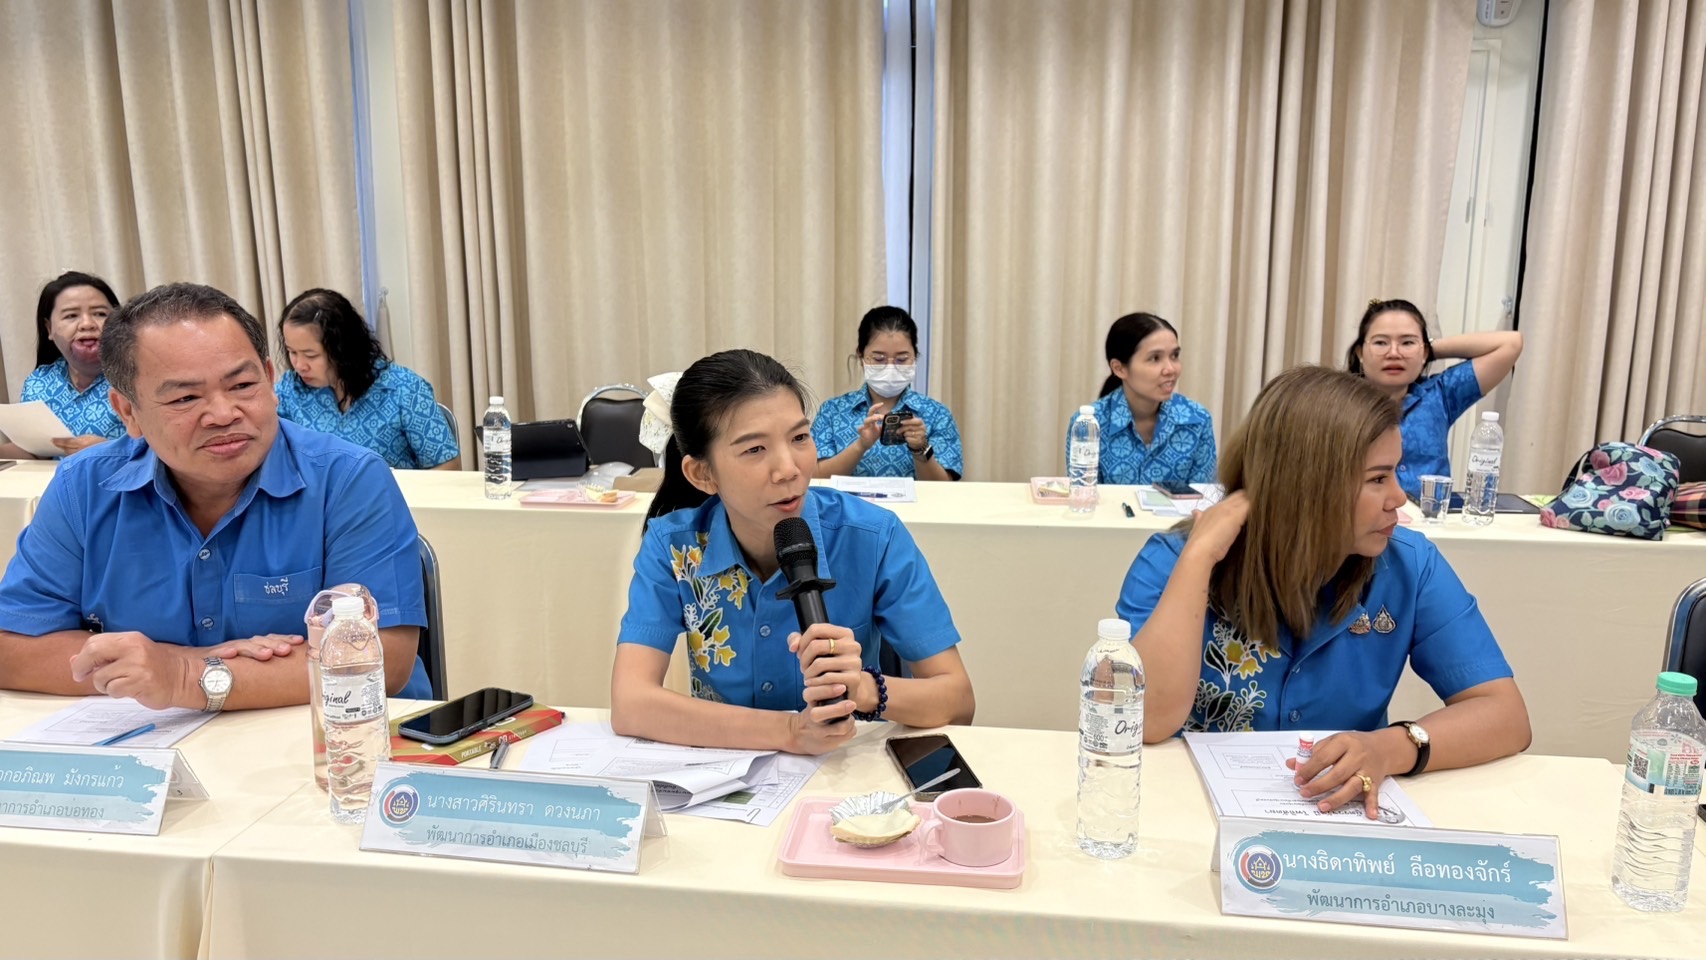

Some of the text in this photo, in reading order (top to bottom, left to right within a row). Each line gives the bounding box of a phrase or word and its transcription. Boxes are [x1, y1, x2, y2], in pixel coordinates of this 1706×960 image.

[264, 577, 289, 596] ชลบุรี
[461, 745, 482, 759] PORTABLE
[63, 765, 124, 788] มังกรแก้ว
[0, 797, 104, 818] าการอำเภอบ่อทอง
[427, 794, 534, 816] นางสาวศิรินทรา
[544, 804, 601, 821] ดวงนภา
[426, 825, 588, 858] พัฒนาการอำเภอเมืองชลบุรี
[1283, 849, 1511, 883] นางธิดาทิพย์ ลือทองจักร์
